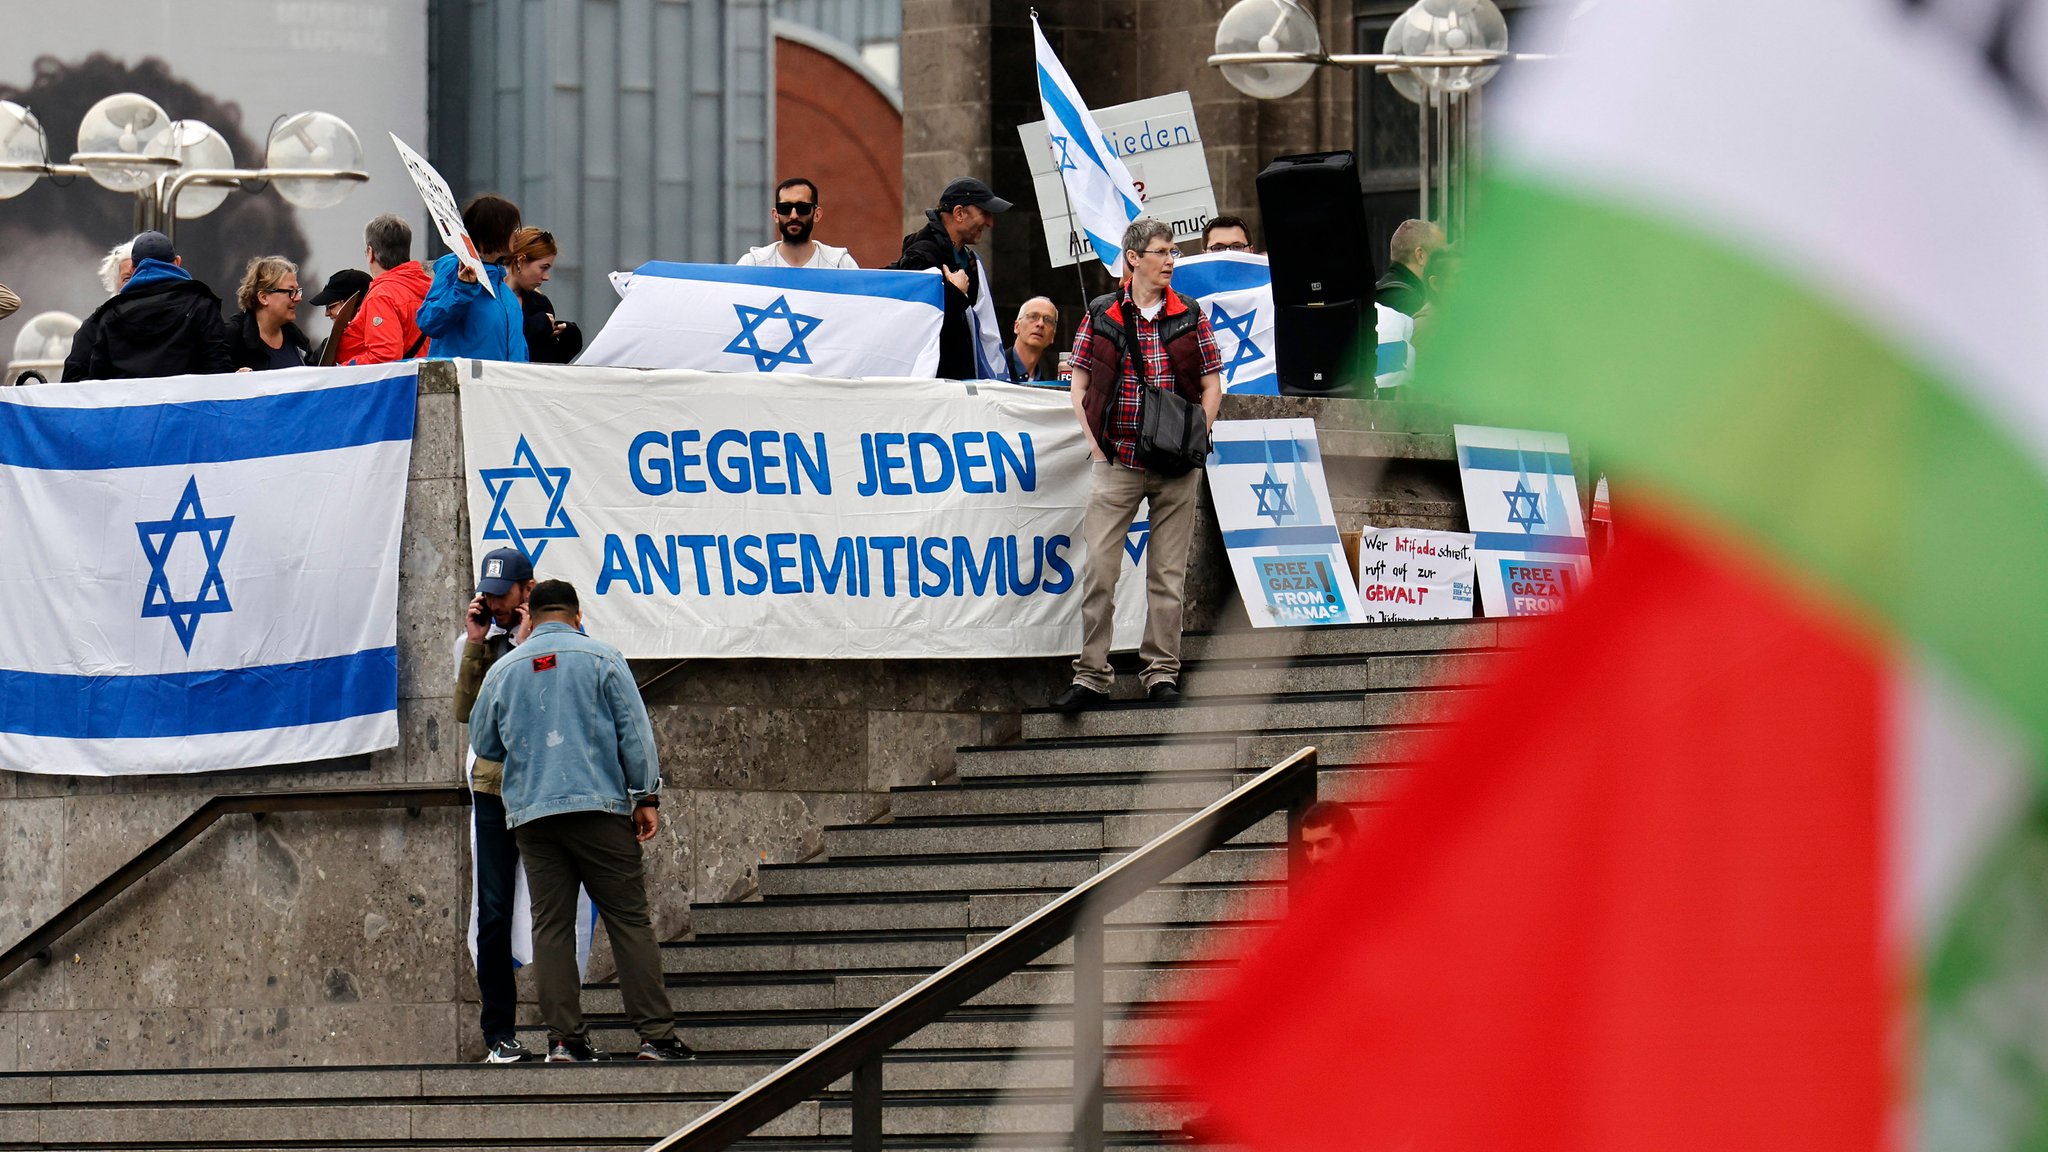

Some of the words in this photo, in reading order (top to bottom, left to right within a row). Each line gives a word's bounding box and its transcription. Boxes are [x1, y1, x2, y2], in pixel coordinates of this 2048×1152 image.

[1112, 120, 1191, 154] ieden
[628, 428, 832, 496] GEGEN
[857, 430, 1037, 497] JEDEN
[1364, 534, 1388, 551] Wer
[1395, 536, 1436, 560] Intifada
[1438, 544, 1472, 561] schreit,
[596, 533, 1075, 598] ANTISEMITISMUS
[1264, 561, 1310, 576] FREE
[1365, 560, 1386, 581] ruft
[1392, 563, 1408, 582] auf
[1417, 568, 1436, 578] zur
[1508, 566, 1554, 581] FREE
[1269, 577, 1318, 590] GAZA
[1511, 582, 1560, 597] GAZA
[1273, 591, 1325, 605] FROM
[1365, 583, 1429, 605] GEWALT
[1279, 605, 1339, 619] HAMAS
